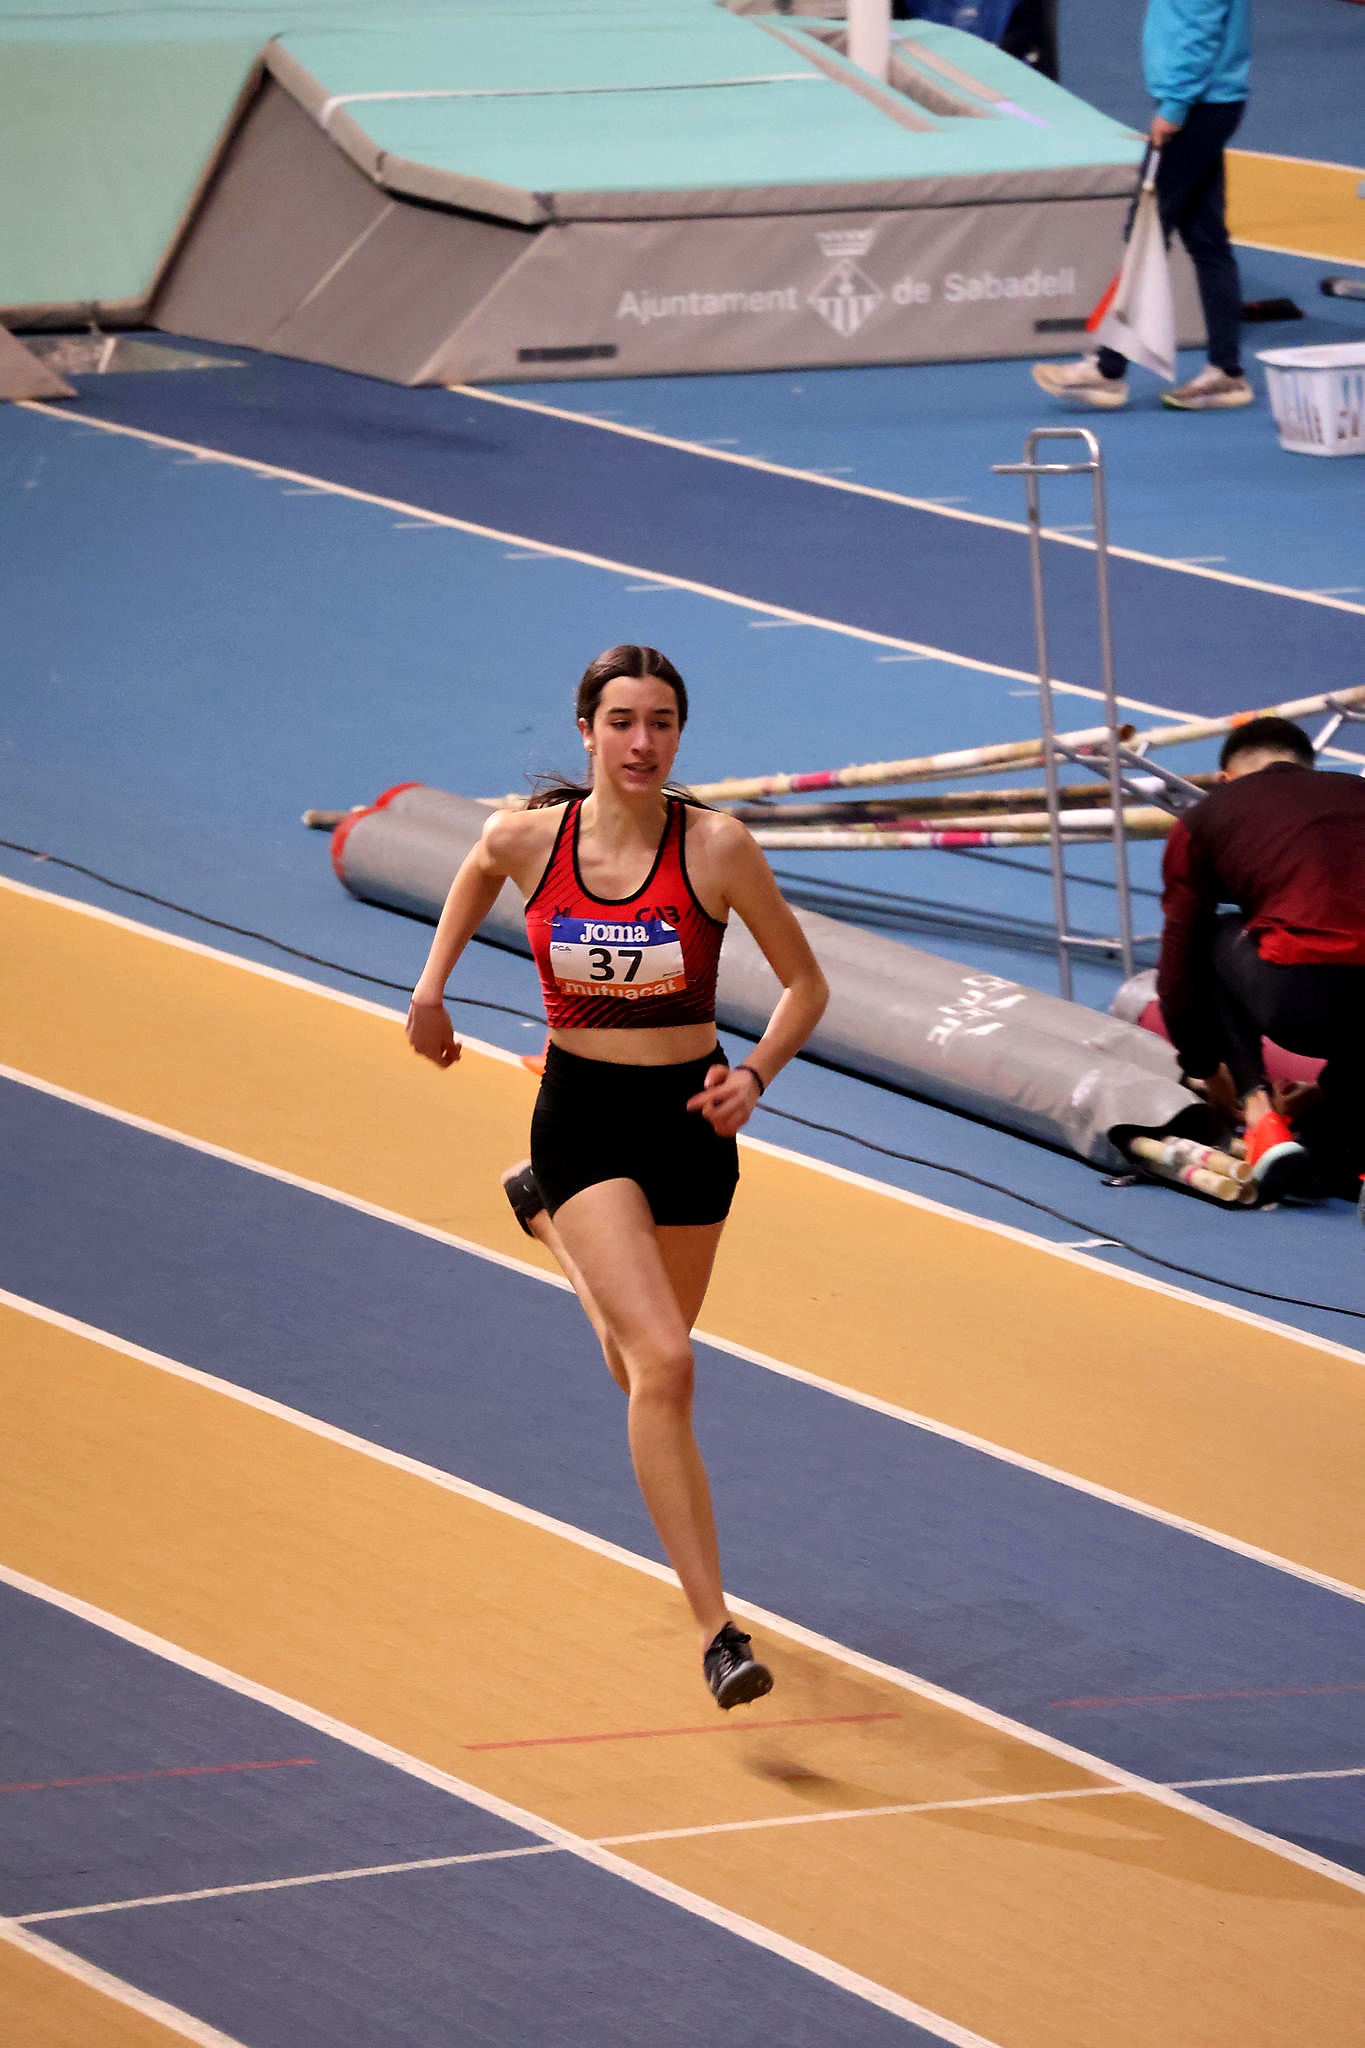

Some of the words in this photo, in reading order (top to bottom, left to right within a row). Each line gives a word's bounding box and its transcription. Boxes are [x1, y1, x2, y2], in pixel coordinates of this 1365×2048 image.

[616, 285, 798, 324] Ajuntament
[892, 277, 932, 306] de
[943, 267, 1076, 303] Sabadell
[588, 947, 644, 983] 37
[565, 978, 677, 1000] mutuacat
